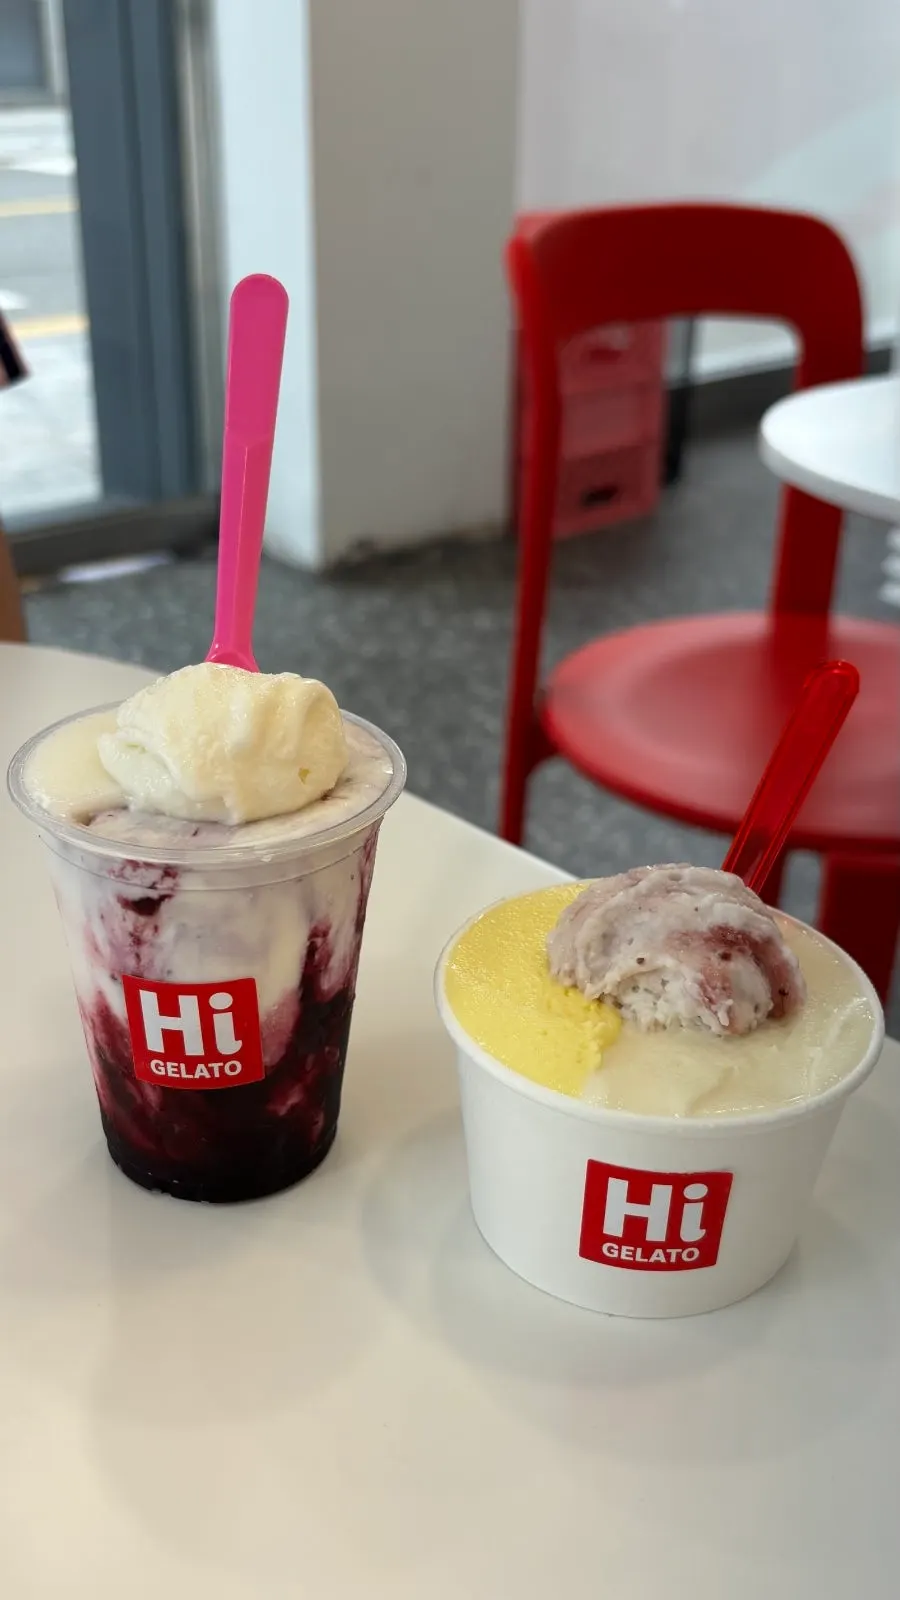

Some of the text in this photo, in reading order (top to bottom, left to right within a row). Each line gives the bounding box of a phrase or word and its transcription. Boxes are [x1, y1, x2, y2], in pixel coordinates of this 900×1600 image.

[139, 989, 243, 1056] Hi
[150, 1059, 242, 1079] GELATO
[602, 1177, 708, 1242] Hi
[602, 1242, 700, 1263] GELATO
